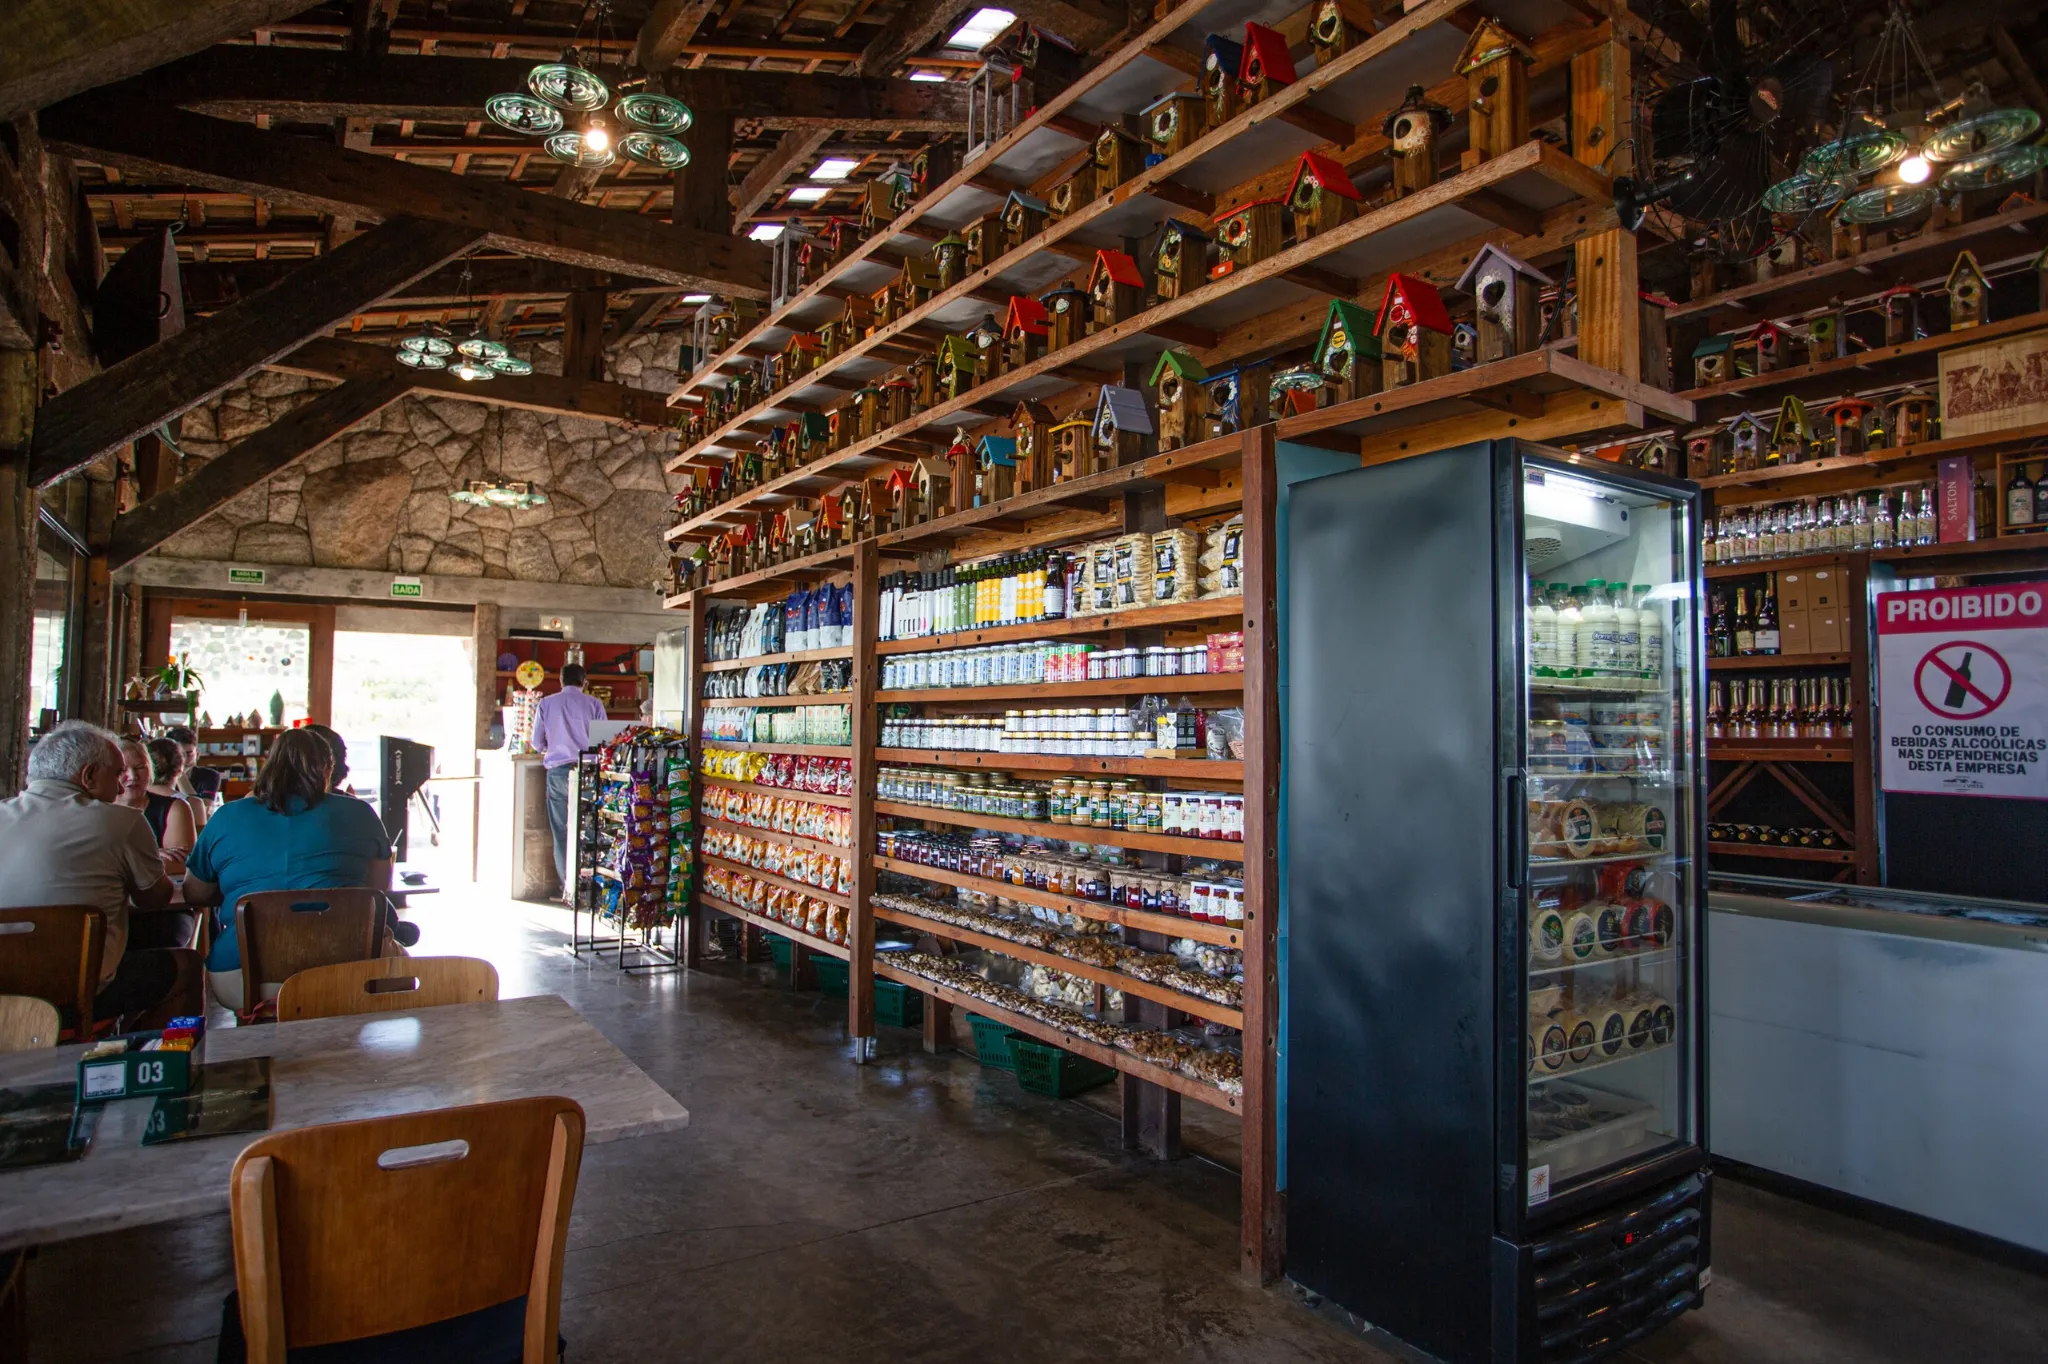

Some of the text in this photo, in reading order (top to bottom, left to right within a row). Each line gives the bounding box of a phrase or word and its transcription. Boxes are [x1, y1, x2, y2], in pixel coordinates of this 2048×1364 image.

[1947, 481, 1958, 521] SALTON
[1887, 591, 2042, 622] PROIBIDO
[1912, 725, 2020, 737] O CONSUMO DE
[1891, 735, 2047, 750] BEBIDAS ALCOÓLICAS
[1898, 749, 1924, 759] NAS
[1908, 761, 2027, 775] DESTA EMPRESA
[137, 1061, 164, 1084] 03
